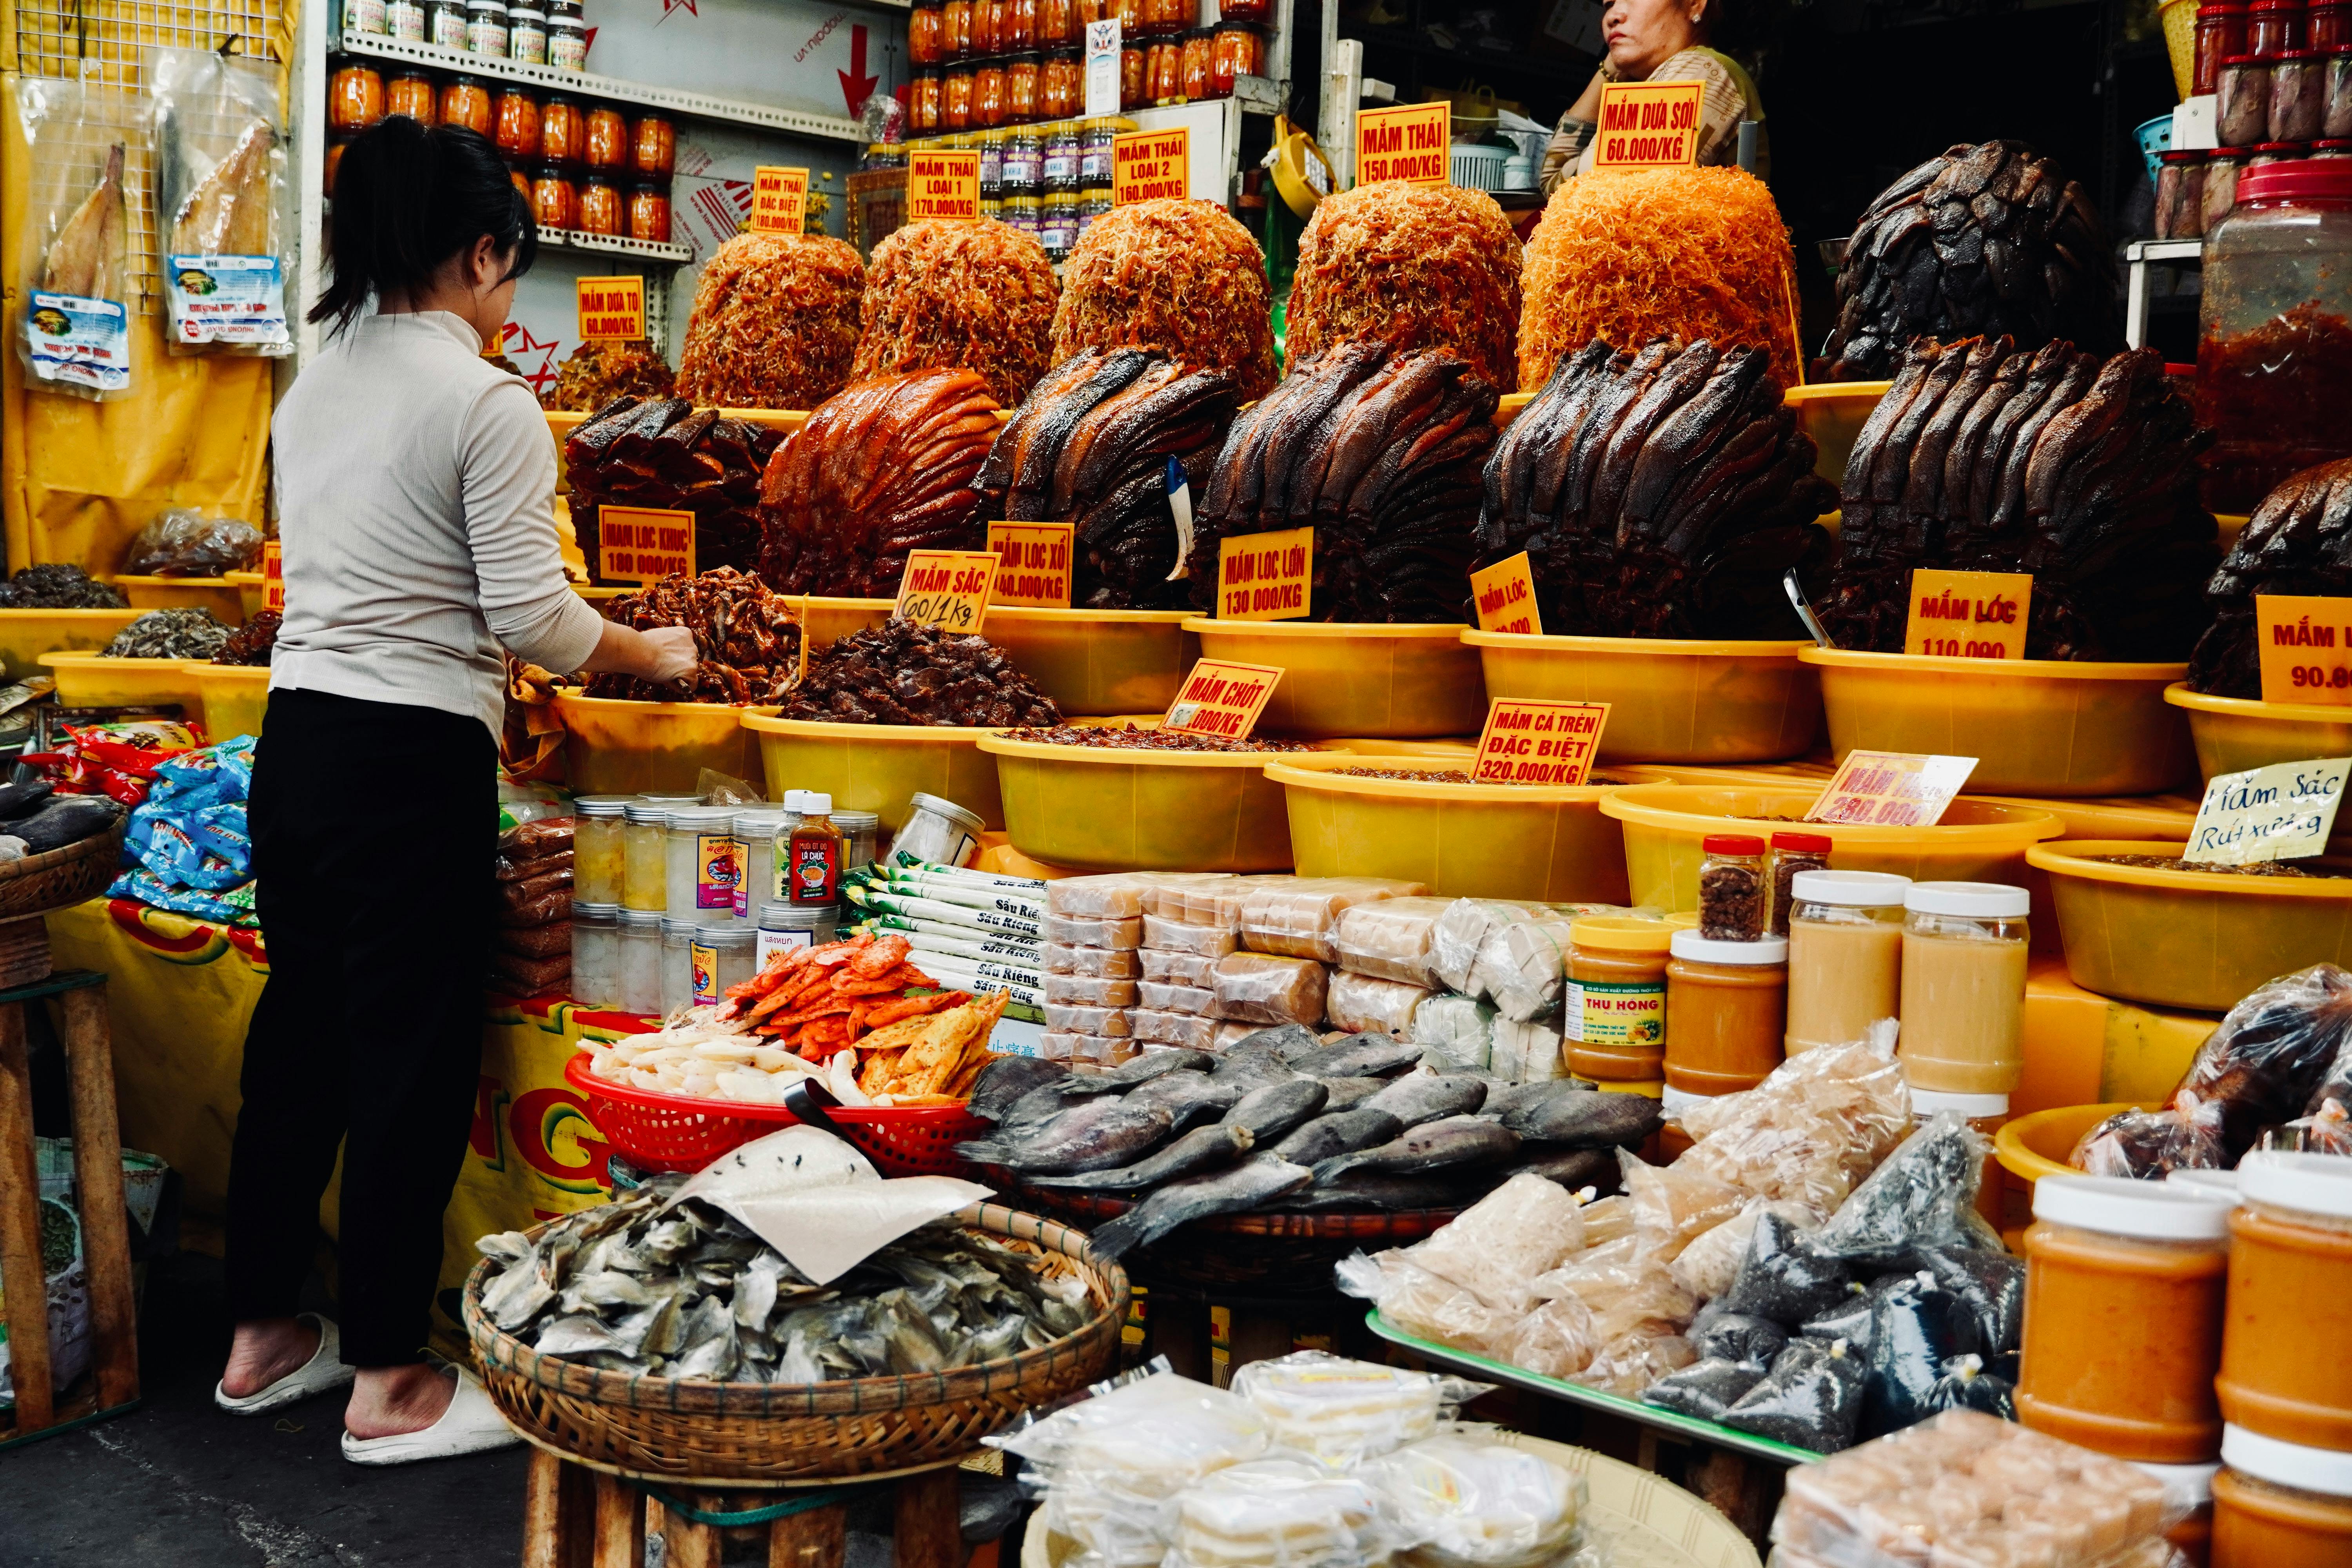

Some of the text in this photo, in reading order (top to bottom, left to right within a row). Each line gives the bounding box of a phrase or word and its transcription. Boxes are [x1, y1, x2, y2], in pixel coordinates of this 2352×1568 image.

[1604, 94, 1639, 131] MẮM
[1364, 117, 1441, 154] MẮM THÁI
[1119, 138, 1182, 162] MẮM THÁI
[1607, 136, 1683, 161] 60.000/KG
[915, 157, 973, 176] MẮM THÁI
[1131, 161, 1169, 181] LOẠI 2
[1365, 154, 1440, 181] 150.000/KG
[760, 174, 802, 194] MẮM THÁI
[927, 180, 961, 197] LOẠI 1
[1120, 180, 1182, 202] 160.000/KG
[779, 196, 798, 215] BIỆT
[915, 199, 973, 215] 170.000/KG
[757, 215, 799, 231] 180.000/KG
[582, 286, 604, 312] MẮM
[627, 292, 638, 312] TO
[587, 317, 635, 334] 60.000/KG
[909, 562, 985, 599] MẮM SẶC
[1479, 577, 1526, 615] MẮM LÓC
[1920, 589, 2017, 624] MẮM LÓC
[2274, 615, 2334, 648] MẮM
[1184, 670, 1227, 703] MẮM
[1495, 708, 1533, 730] MẮM
[1535, 711, 1555, 731] CÁ
[1488, 735, 1588, 761] ĐẶC BIỆT
[1480, 760, 1579, 784] 320.000/KG
[802, 851, 824, 860] LÁ CHÚC
[1002, 968, 1039, 987] Riêng
[1586, 998, 1659, 1010] THU HỒNG
